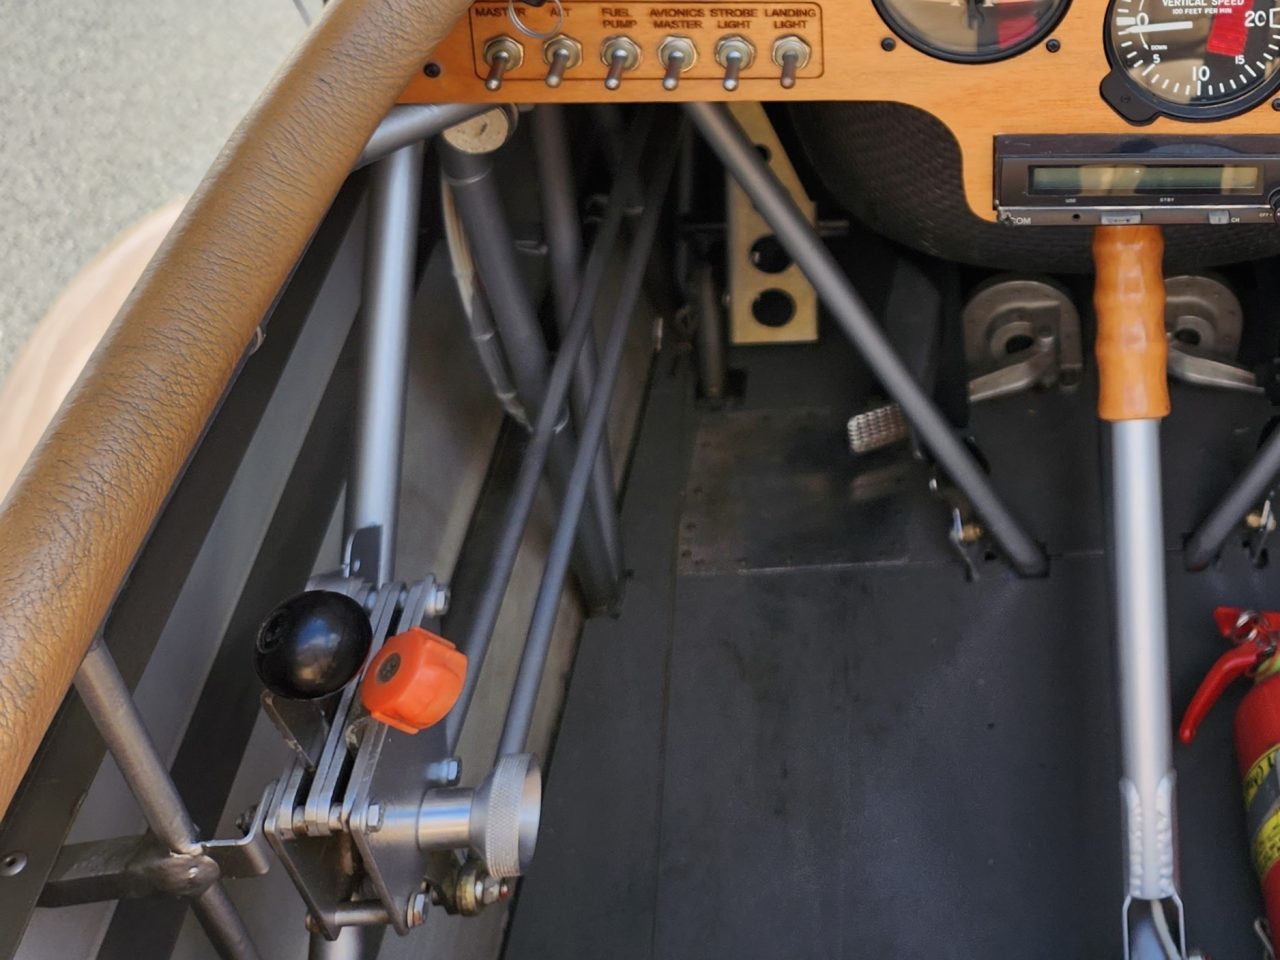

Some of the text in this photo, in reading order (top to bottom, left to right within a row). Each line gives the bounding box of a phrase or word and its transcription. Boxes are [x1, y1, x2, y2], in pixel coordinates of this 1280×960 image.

[475, 8, 526, 17] MASTR
[601, 8, 634, 18] FUEL
[650, 8, 706, 18] AVIONICS
[710, 8, 758, 18] STROBE
[764, 8, 816, 18] LANDING
[1136, 12, 1149, 26] 0
[1244, 10, 1266, 27] 20
[602, 20, 638, 28] PUMP
[654, 20, 702, 29] MASTER
[717, 20, 752, 29] LIGHT
[774, 20, 808, 29] LIGHT
[1153, 54, 1160, 64] 5
[1235, 55, 1245, 64] 15
[1192, 66, 1210, 82] 10
